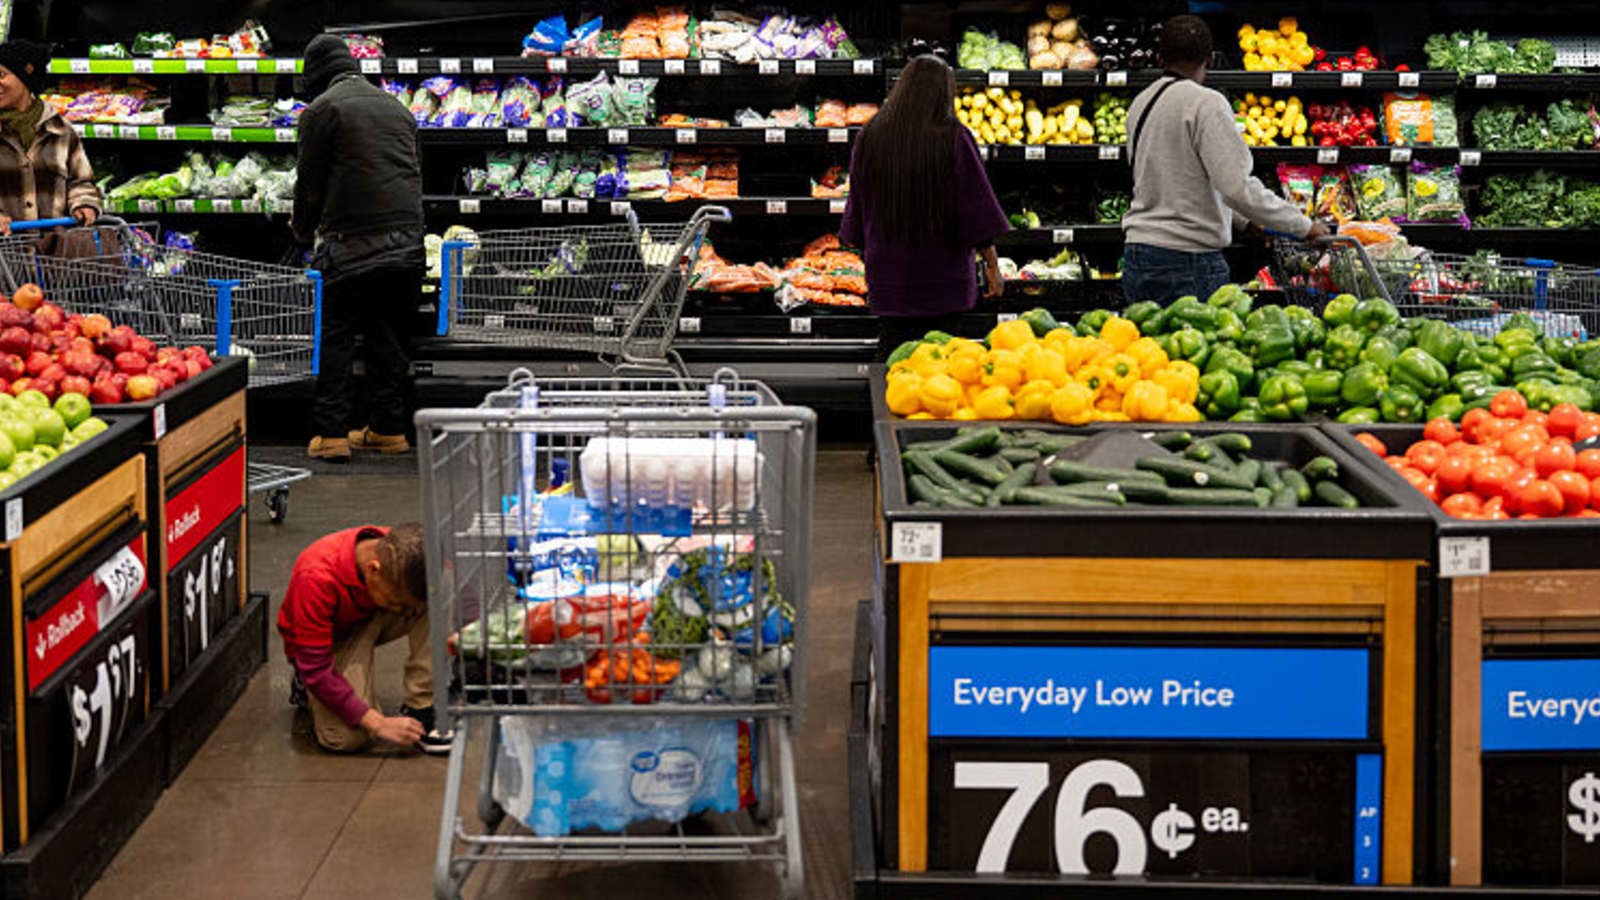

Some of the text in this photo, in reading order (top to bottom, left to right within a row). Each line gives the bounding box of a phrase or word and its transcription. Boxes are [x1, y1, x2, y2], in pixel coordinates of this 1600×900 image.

[174, 503, 200, 540] Rollback
[47, 601, 86, 649] Rollback
[953, 678, 1234, 713] Everyday Low Price
[1201, 807, 1249, 832] ea.
